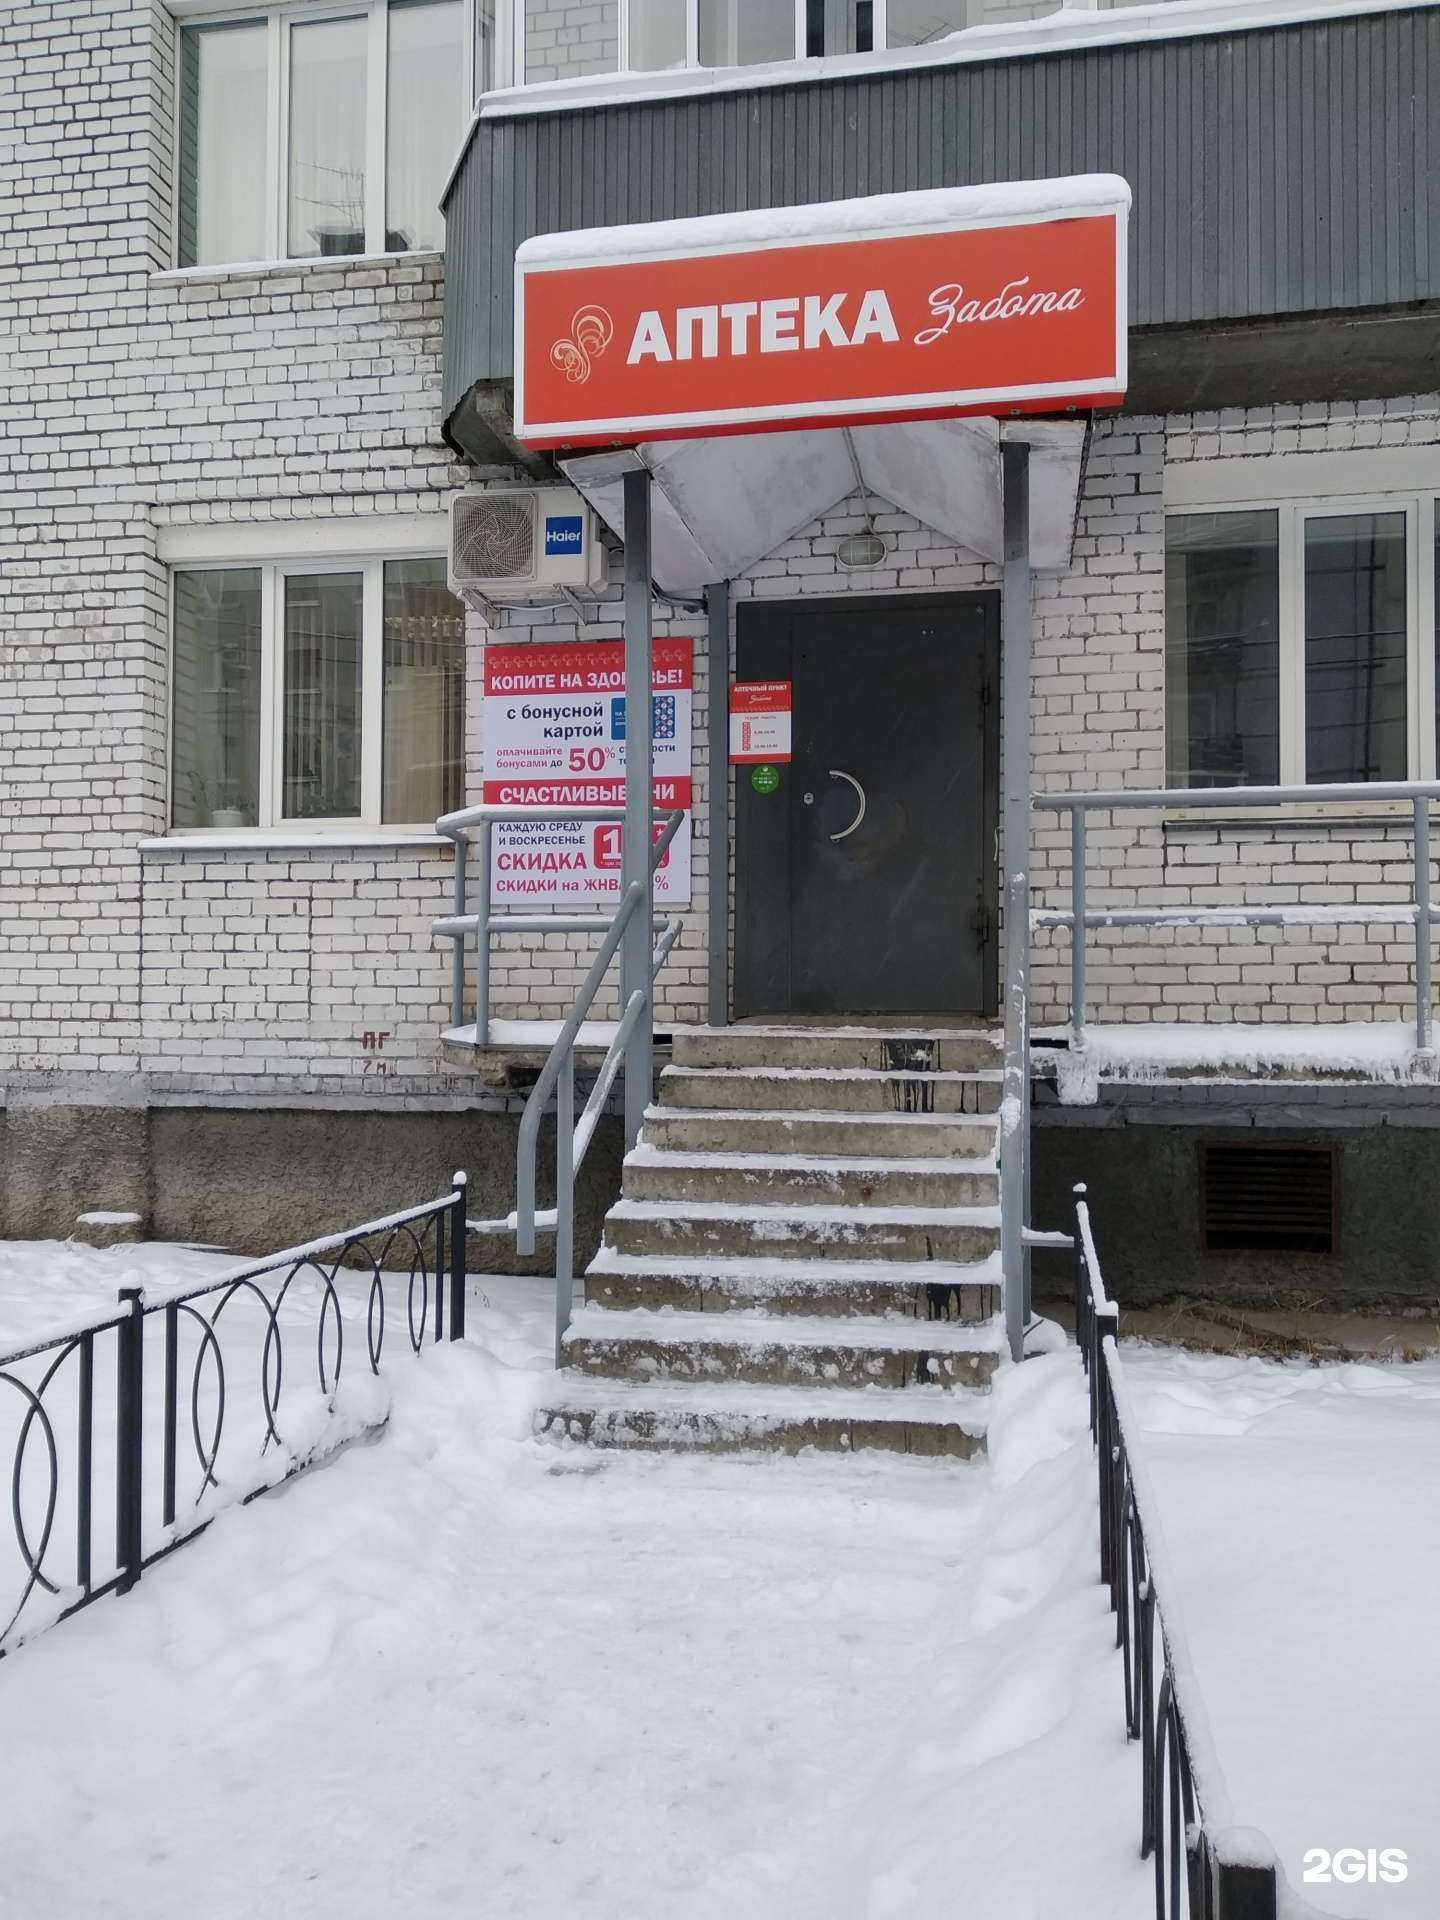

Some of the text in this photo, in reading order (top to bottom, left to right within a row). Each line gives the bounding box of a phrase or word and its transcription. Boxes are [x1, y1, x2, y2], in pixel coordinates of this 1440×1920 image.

[626, 276, 1086, 364] АПТЕКА Забота
[546, 530, 581, 543] Haier
[491, 674, 556, 690] КОПИТЕ
[561, 674, 583, 688] НА
[506, 701, 603, 721] с бонусной
[543, 722, 603, 740] картой
[496, 745, 563, 757] оплачивайте
[496, 758, 563, 770] бонусами до
[500, 783, 675, 804] СЧАСТЛИВЫЕ НИ
[498, 822, 583, 833] КАЖДУЮ СРЕДУ
[498, 835, 586, 846] И ВОСКРЕСЕНЬЕ
[497, 852, 588, 873] СКИДКА
[496, 879, 557, 893] СКИДКИ
[562, 882, 579, 891] на
[362, 1031, 391, 1050] ПГ
